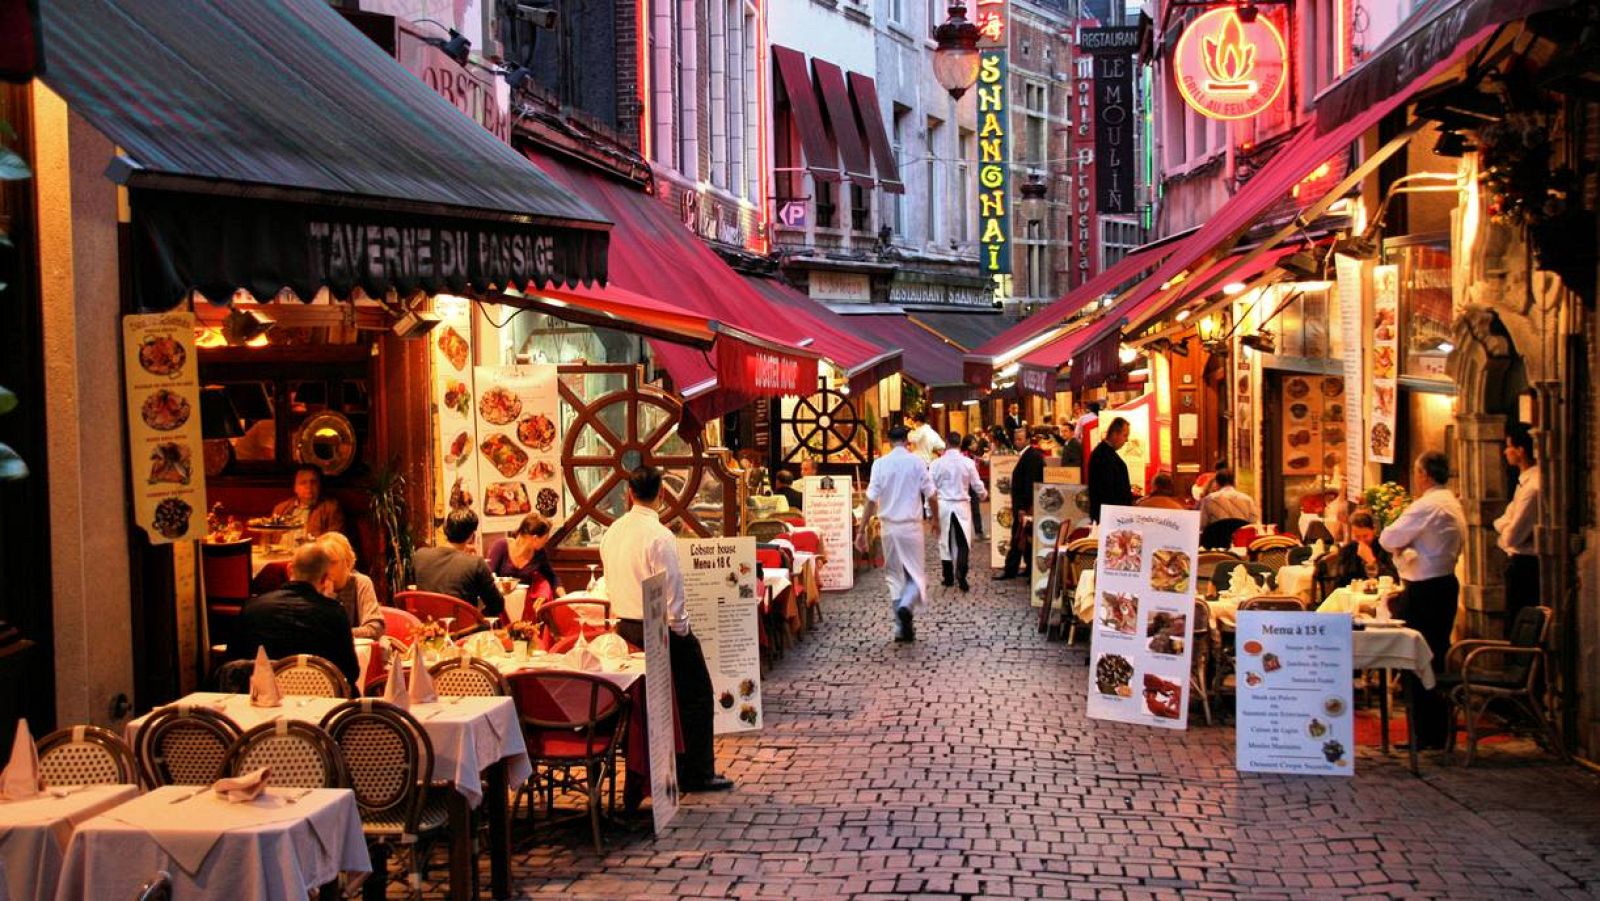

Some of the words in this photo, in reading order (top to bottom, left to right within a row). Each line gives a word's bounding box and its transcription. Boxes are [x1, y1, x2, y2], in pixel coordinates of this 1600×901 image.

[1081, 31, 1137, 47] RESTAURAN
[789, 205, 804, 226] P
[310, 222, 433, 278] TAVERNE
[440, 229, 469, 279] DU
[479, 231, 555, 277] PASSAGE
[1262, 624, 1293, 635] Menu
[1305, 624, 1317, 636] 13
[1319, 625, 1326, 636] €
